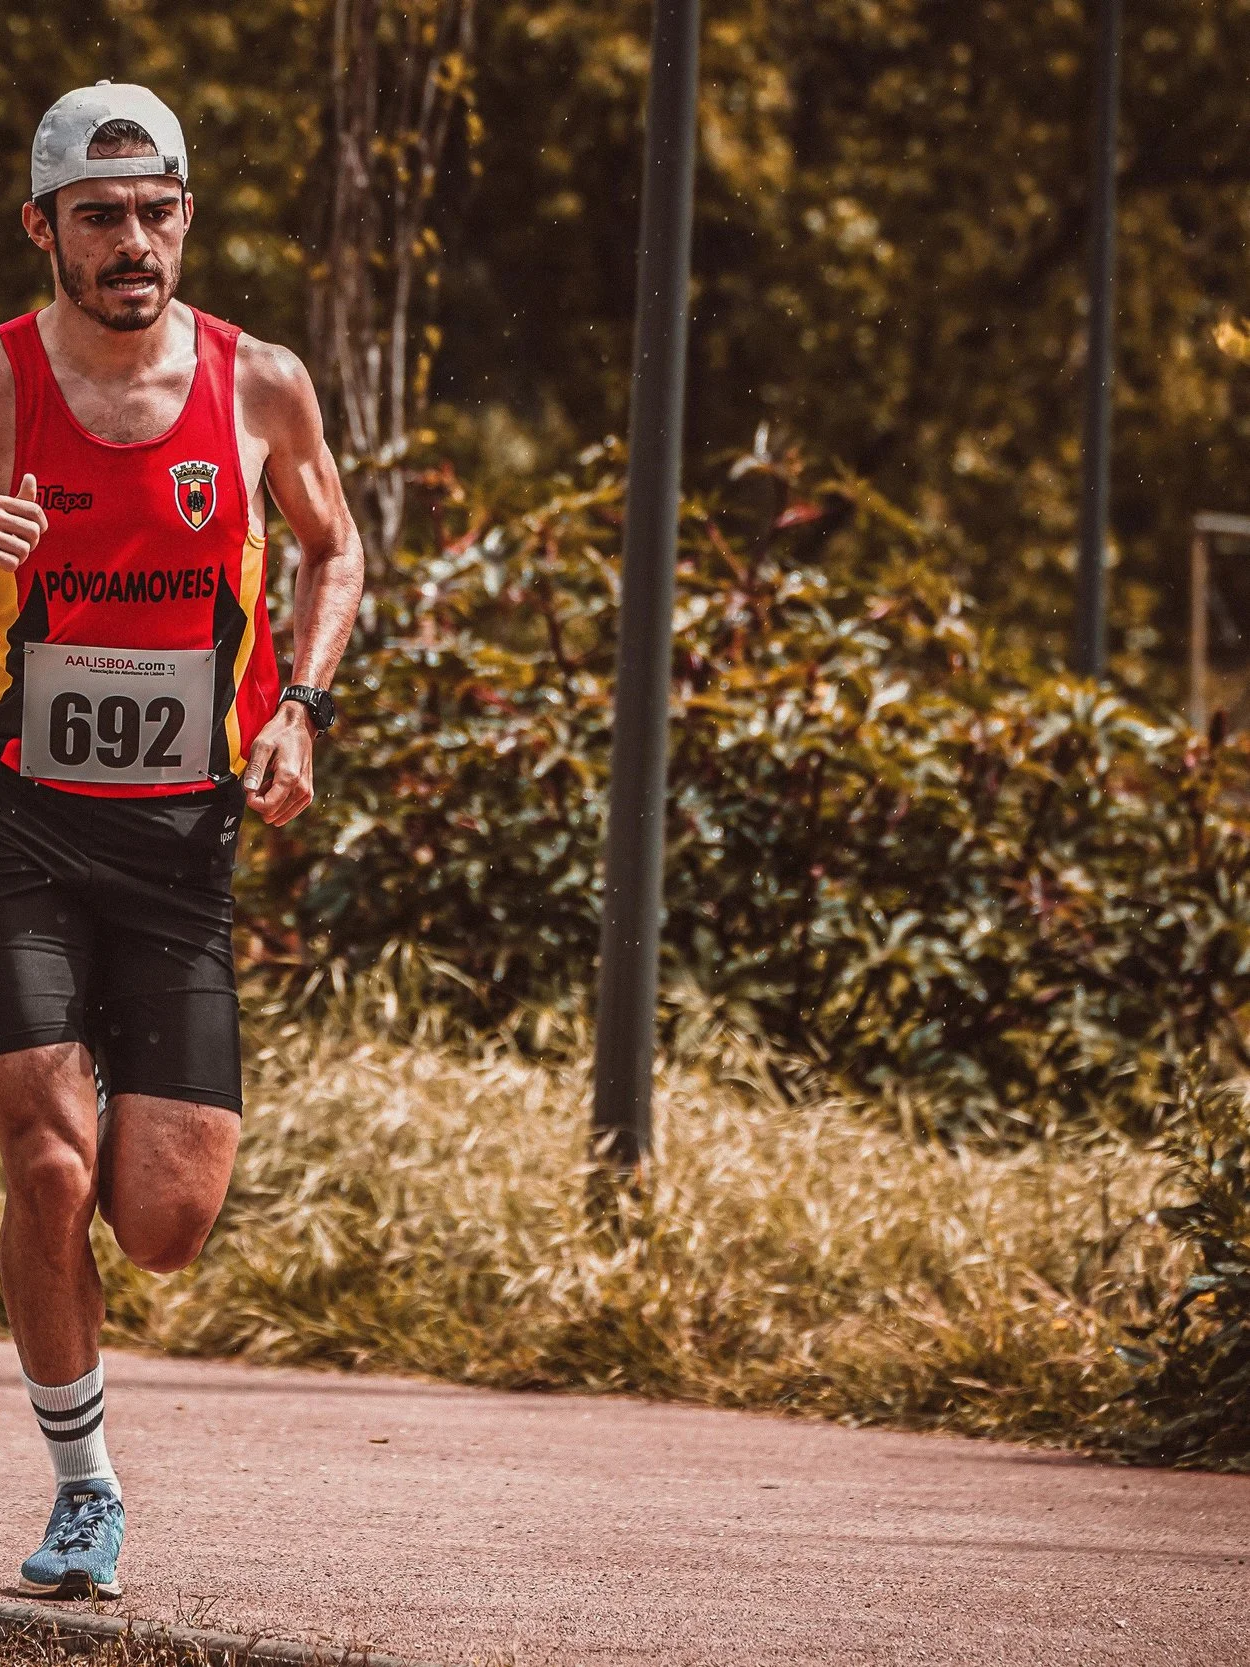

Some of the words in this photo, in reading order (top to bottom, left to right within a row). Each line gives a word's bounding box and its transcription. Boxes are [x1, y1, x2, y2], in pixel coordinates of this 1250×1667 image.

[45, 562, 214, 603] PÓVOAMOVEIS
[65, 655, 165, 671] AALISBOA.com
[49, 692, 186, 768] 692
